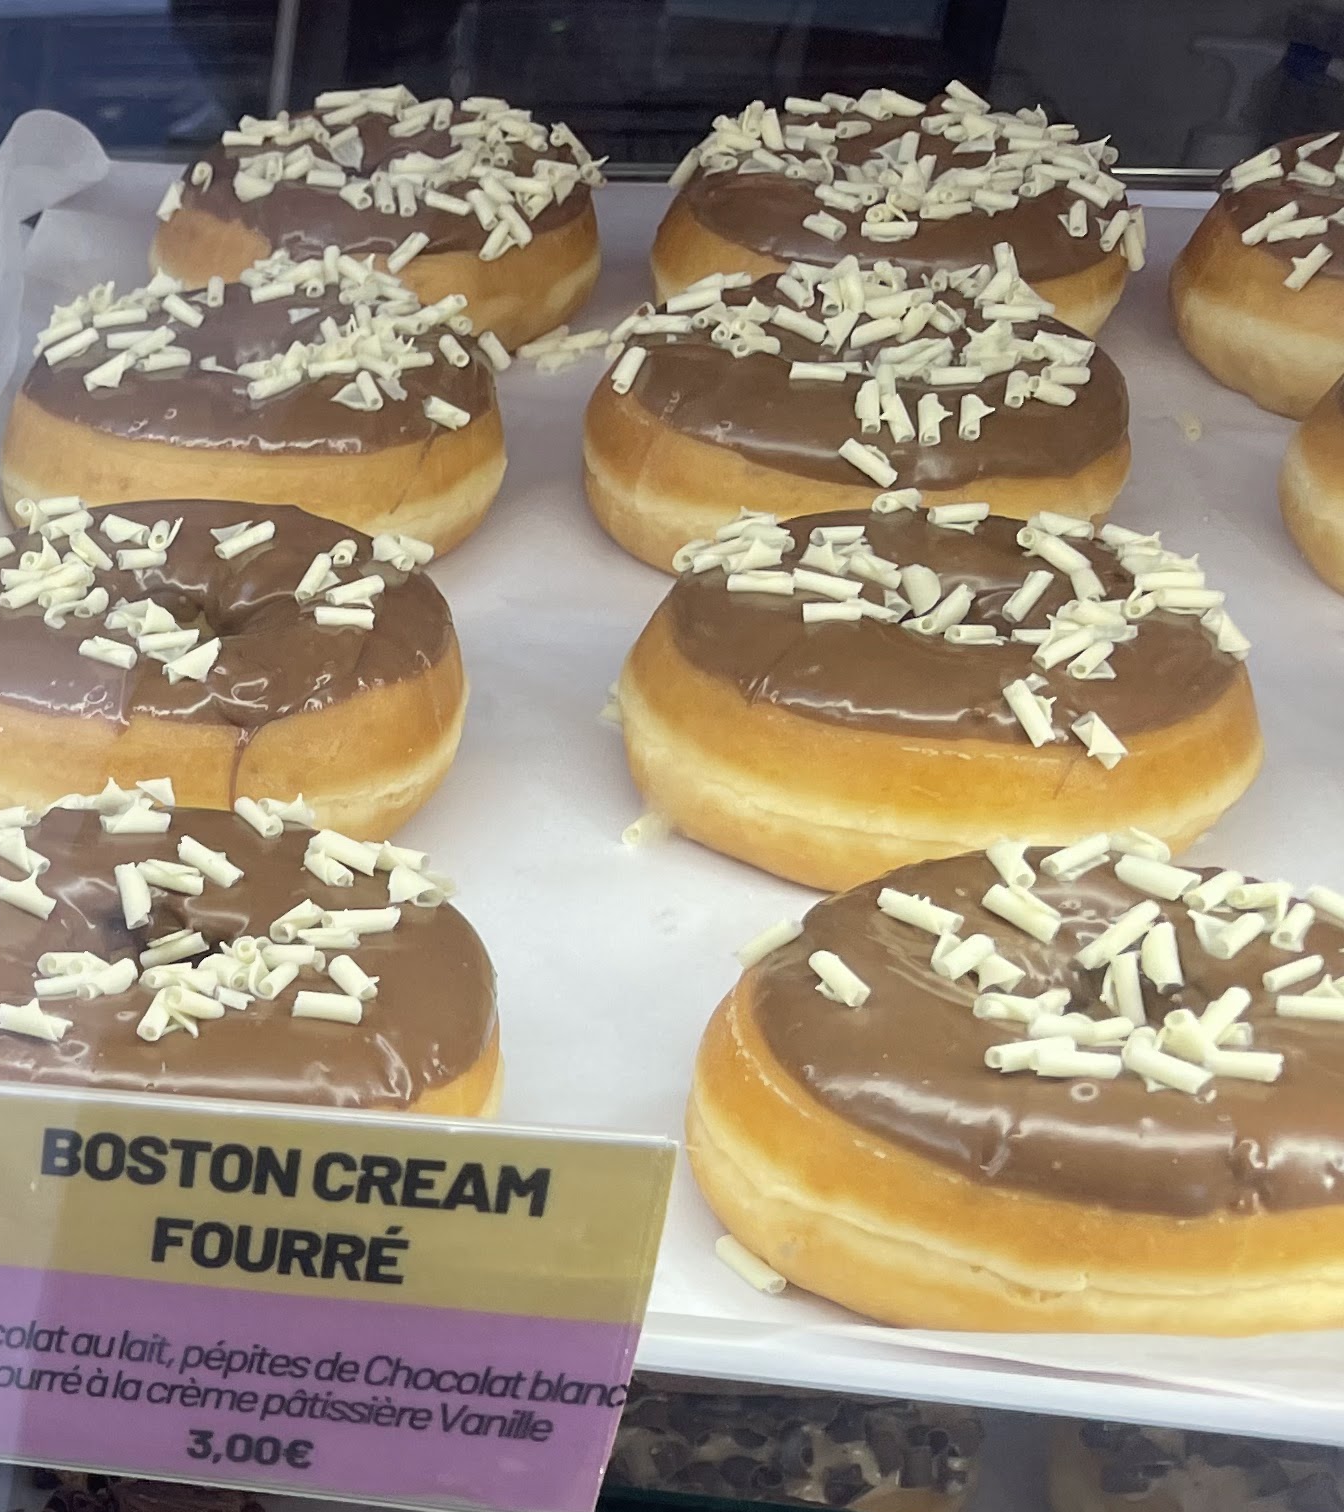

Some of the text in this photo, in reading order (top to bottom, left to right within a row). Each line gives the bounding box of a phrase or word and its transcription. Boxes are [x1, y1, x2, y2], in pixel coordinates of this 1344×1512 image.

[40, 1127, 551, 1217] BOSTON CREAM
[151, 1216, 411, 1285] FOURRÉ
[71, 1332, 115, 1359] au
[118, 1330, 174, 1369] lait,
[179, 1340, 311, 1379] pépites
[314, 1352, 360, 1383] de
[364, 1355, 526, 1401] Chocolat
[528, 1370, 628, 1408] blanc
[86, 1368, 110, 1399] à
[112, 1370, 142, 1402] la
[146, 1377, 260, 1413] crème
[260, 1388, 434, 1432] pâtissière
[440, 1403, 554, 1442] Vanille
[186, 1429, 315, 1469] 3,00€
